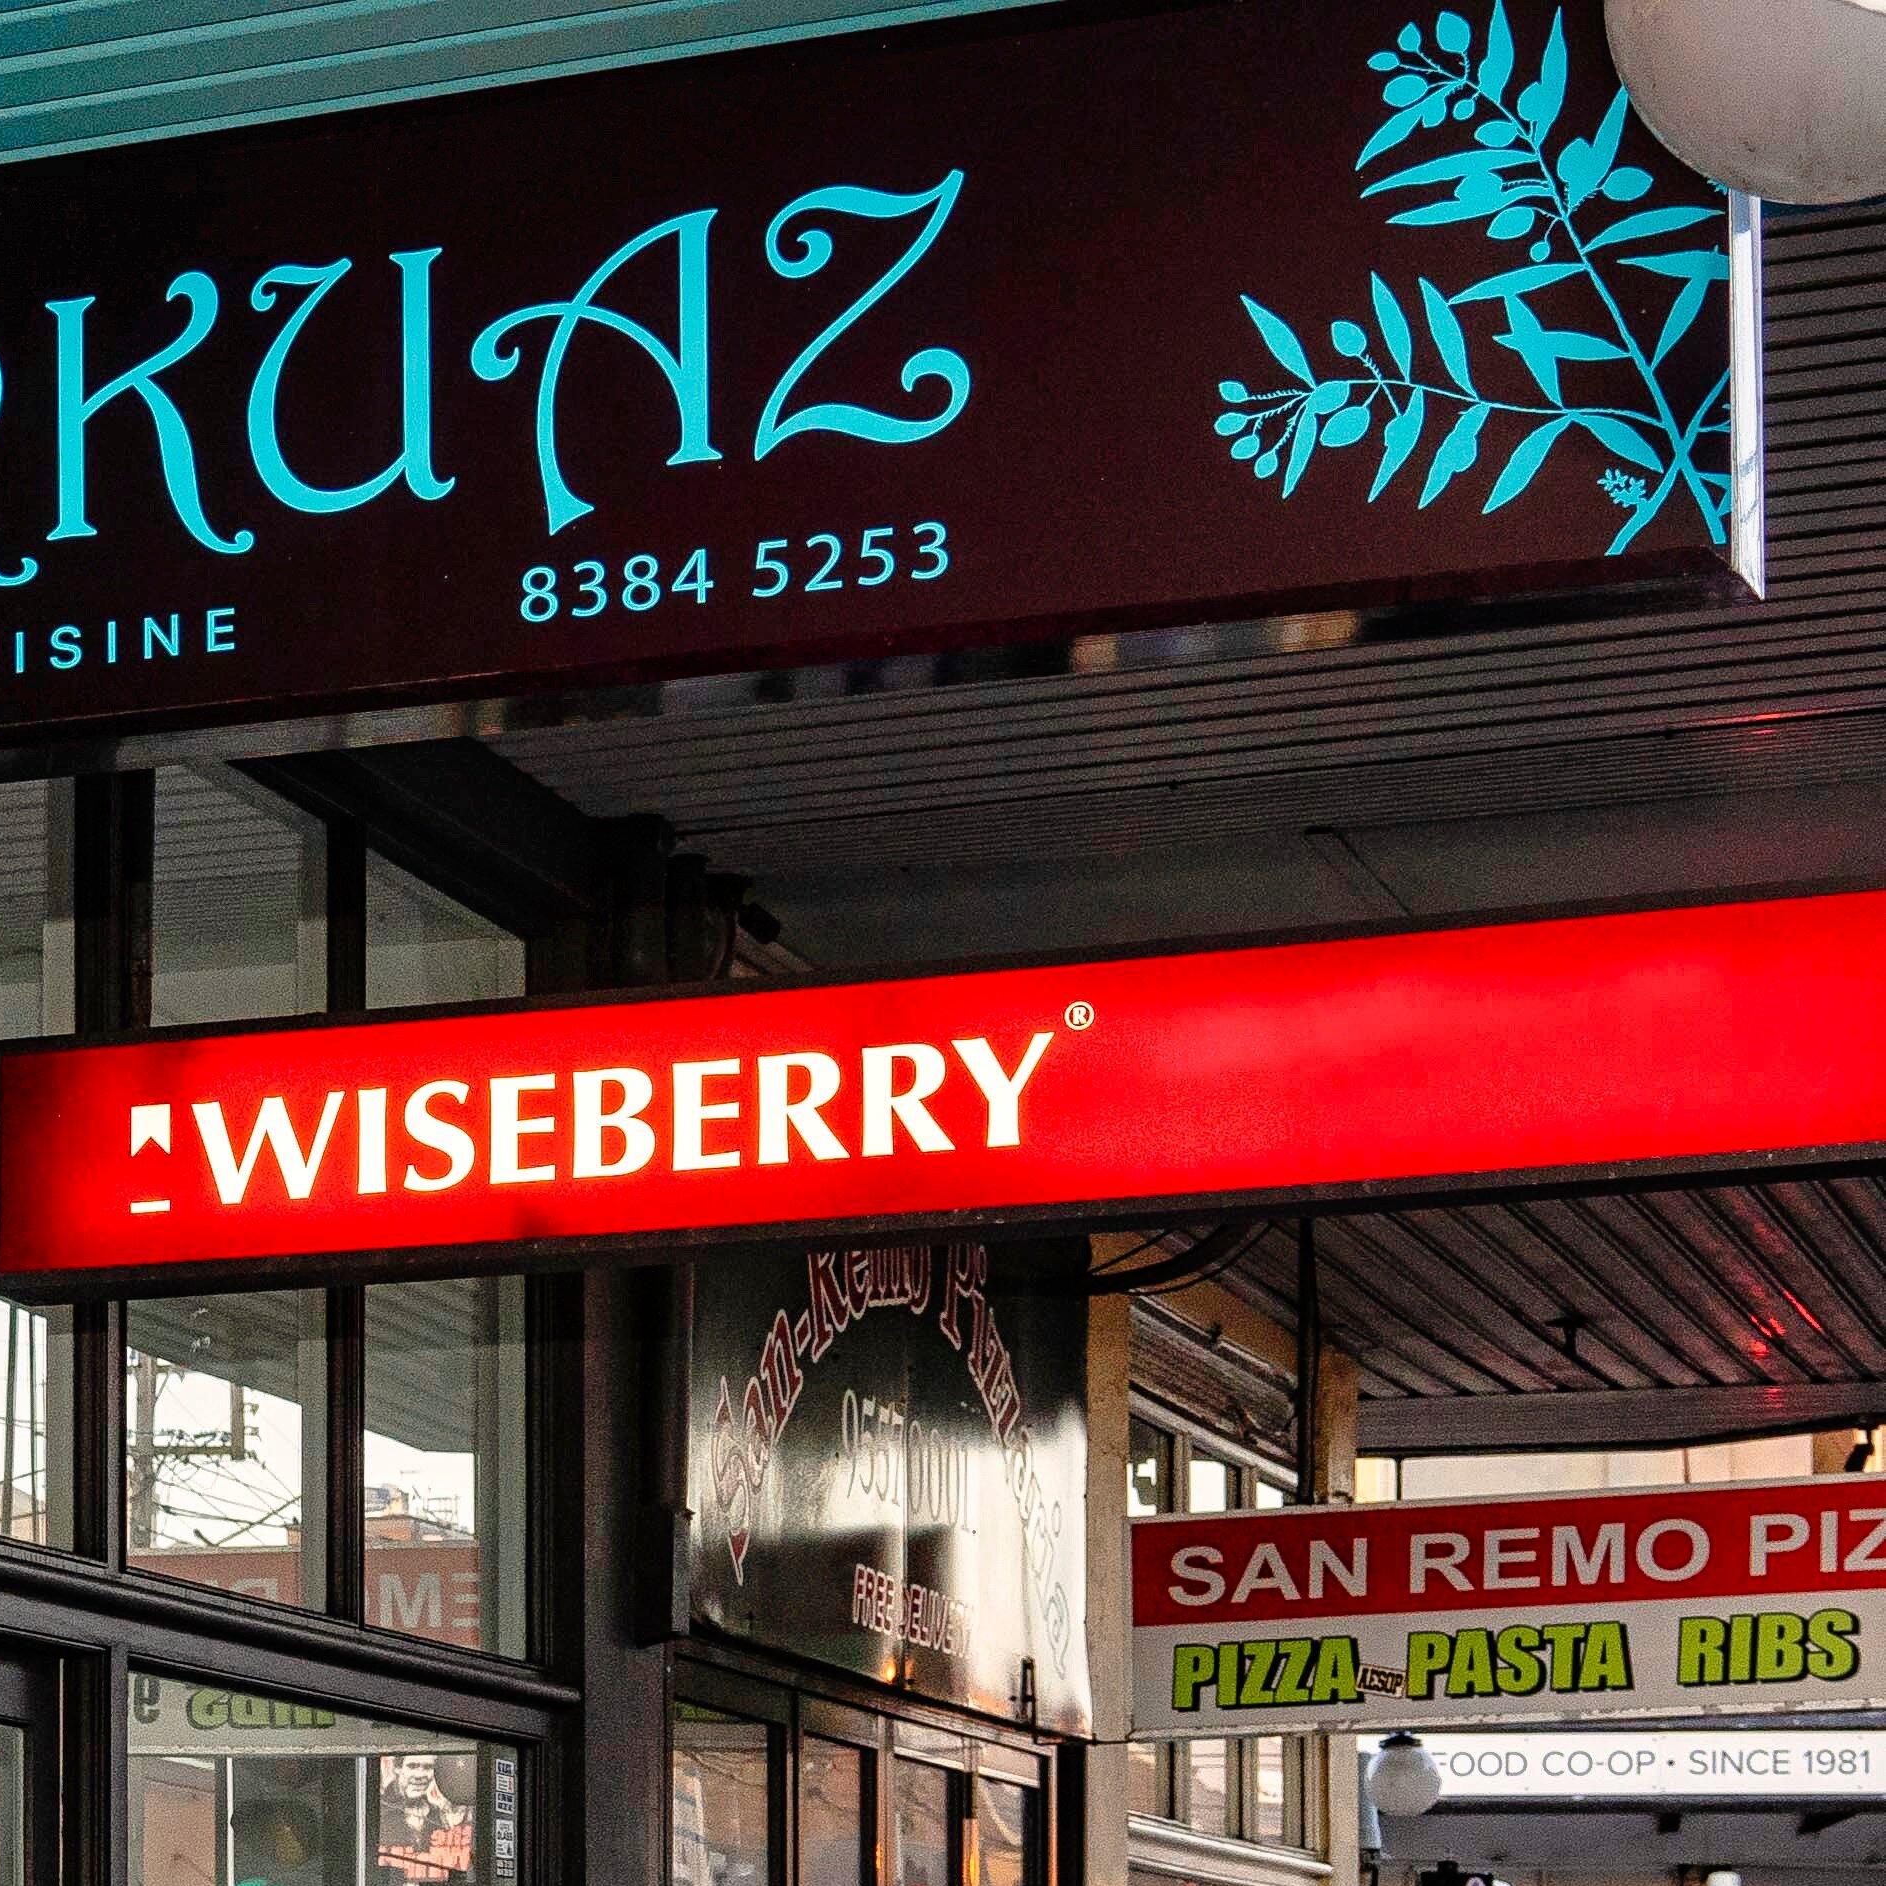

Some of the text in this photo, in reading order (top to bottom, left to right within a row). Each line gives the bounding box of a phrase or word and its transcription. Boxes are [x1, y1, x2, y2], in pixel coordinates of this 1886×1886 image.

[519, 522, 952, 624] 8384 5253
[192, 1031, 1056, 1206] WISEBERRY
[1168, 1537, 1369, 1607] SAN
[1409, 1517, 1711, 1595] REMO
[1172, 1608, 1860, 1713] PIZZA PASTA RIBS
[1542, 1749, 1657, 1778] CO-OP
[1689, 1749, 1793, 1776] SINCE
[1802, 1748, 1871, 1776] 1981
